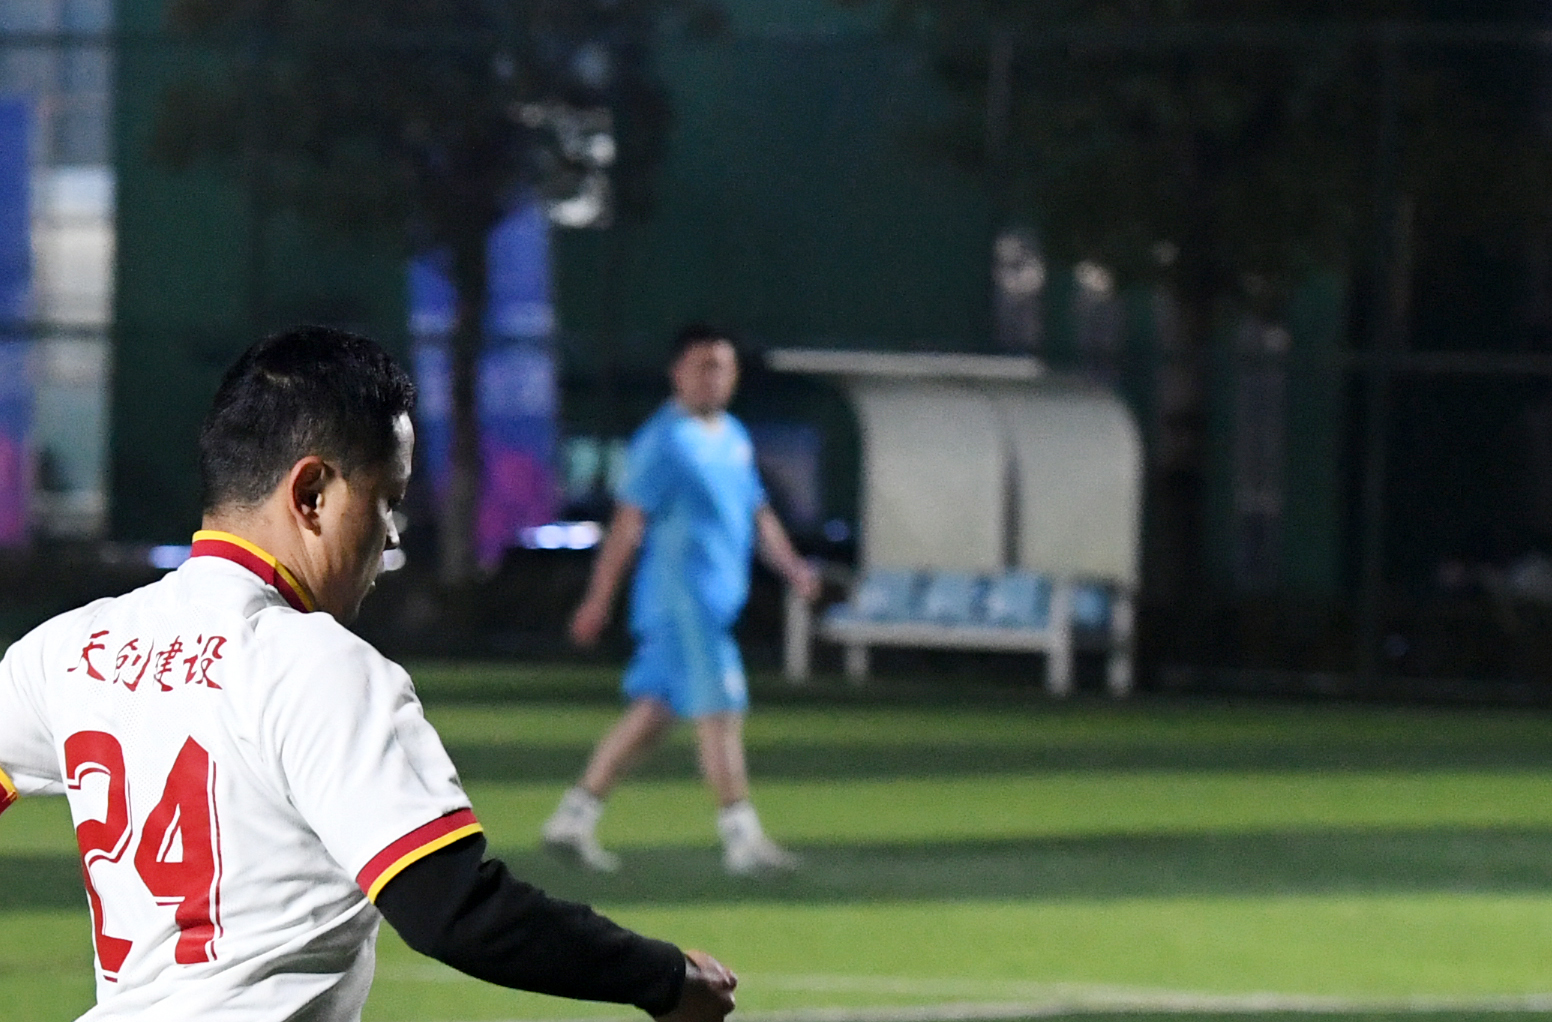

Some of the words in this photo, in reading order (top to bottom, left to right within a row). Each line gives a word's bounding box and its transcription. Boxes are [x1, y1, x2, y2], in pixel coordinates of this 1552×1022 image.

[66, 629, 228, 693] 天创建设
[63, 729, 224, 984] 24
